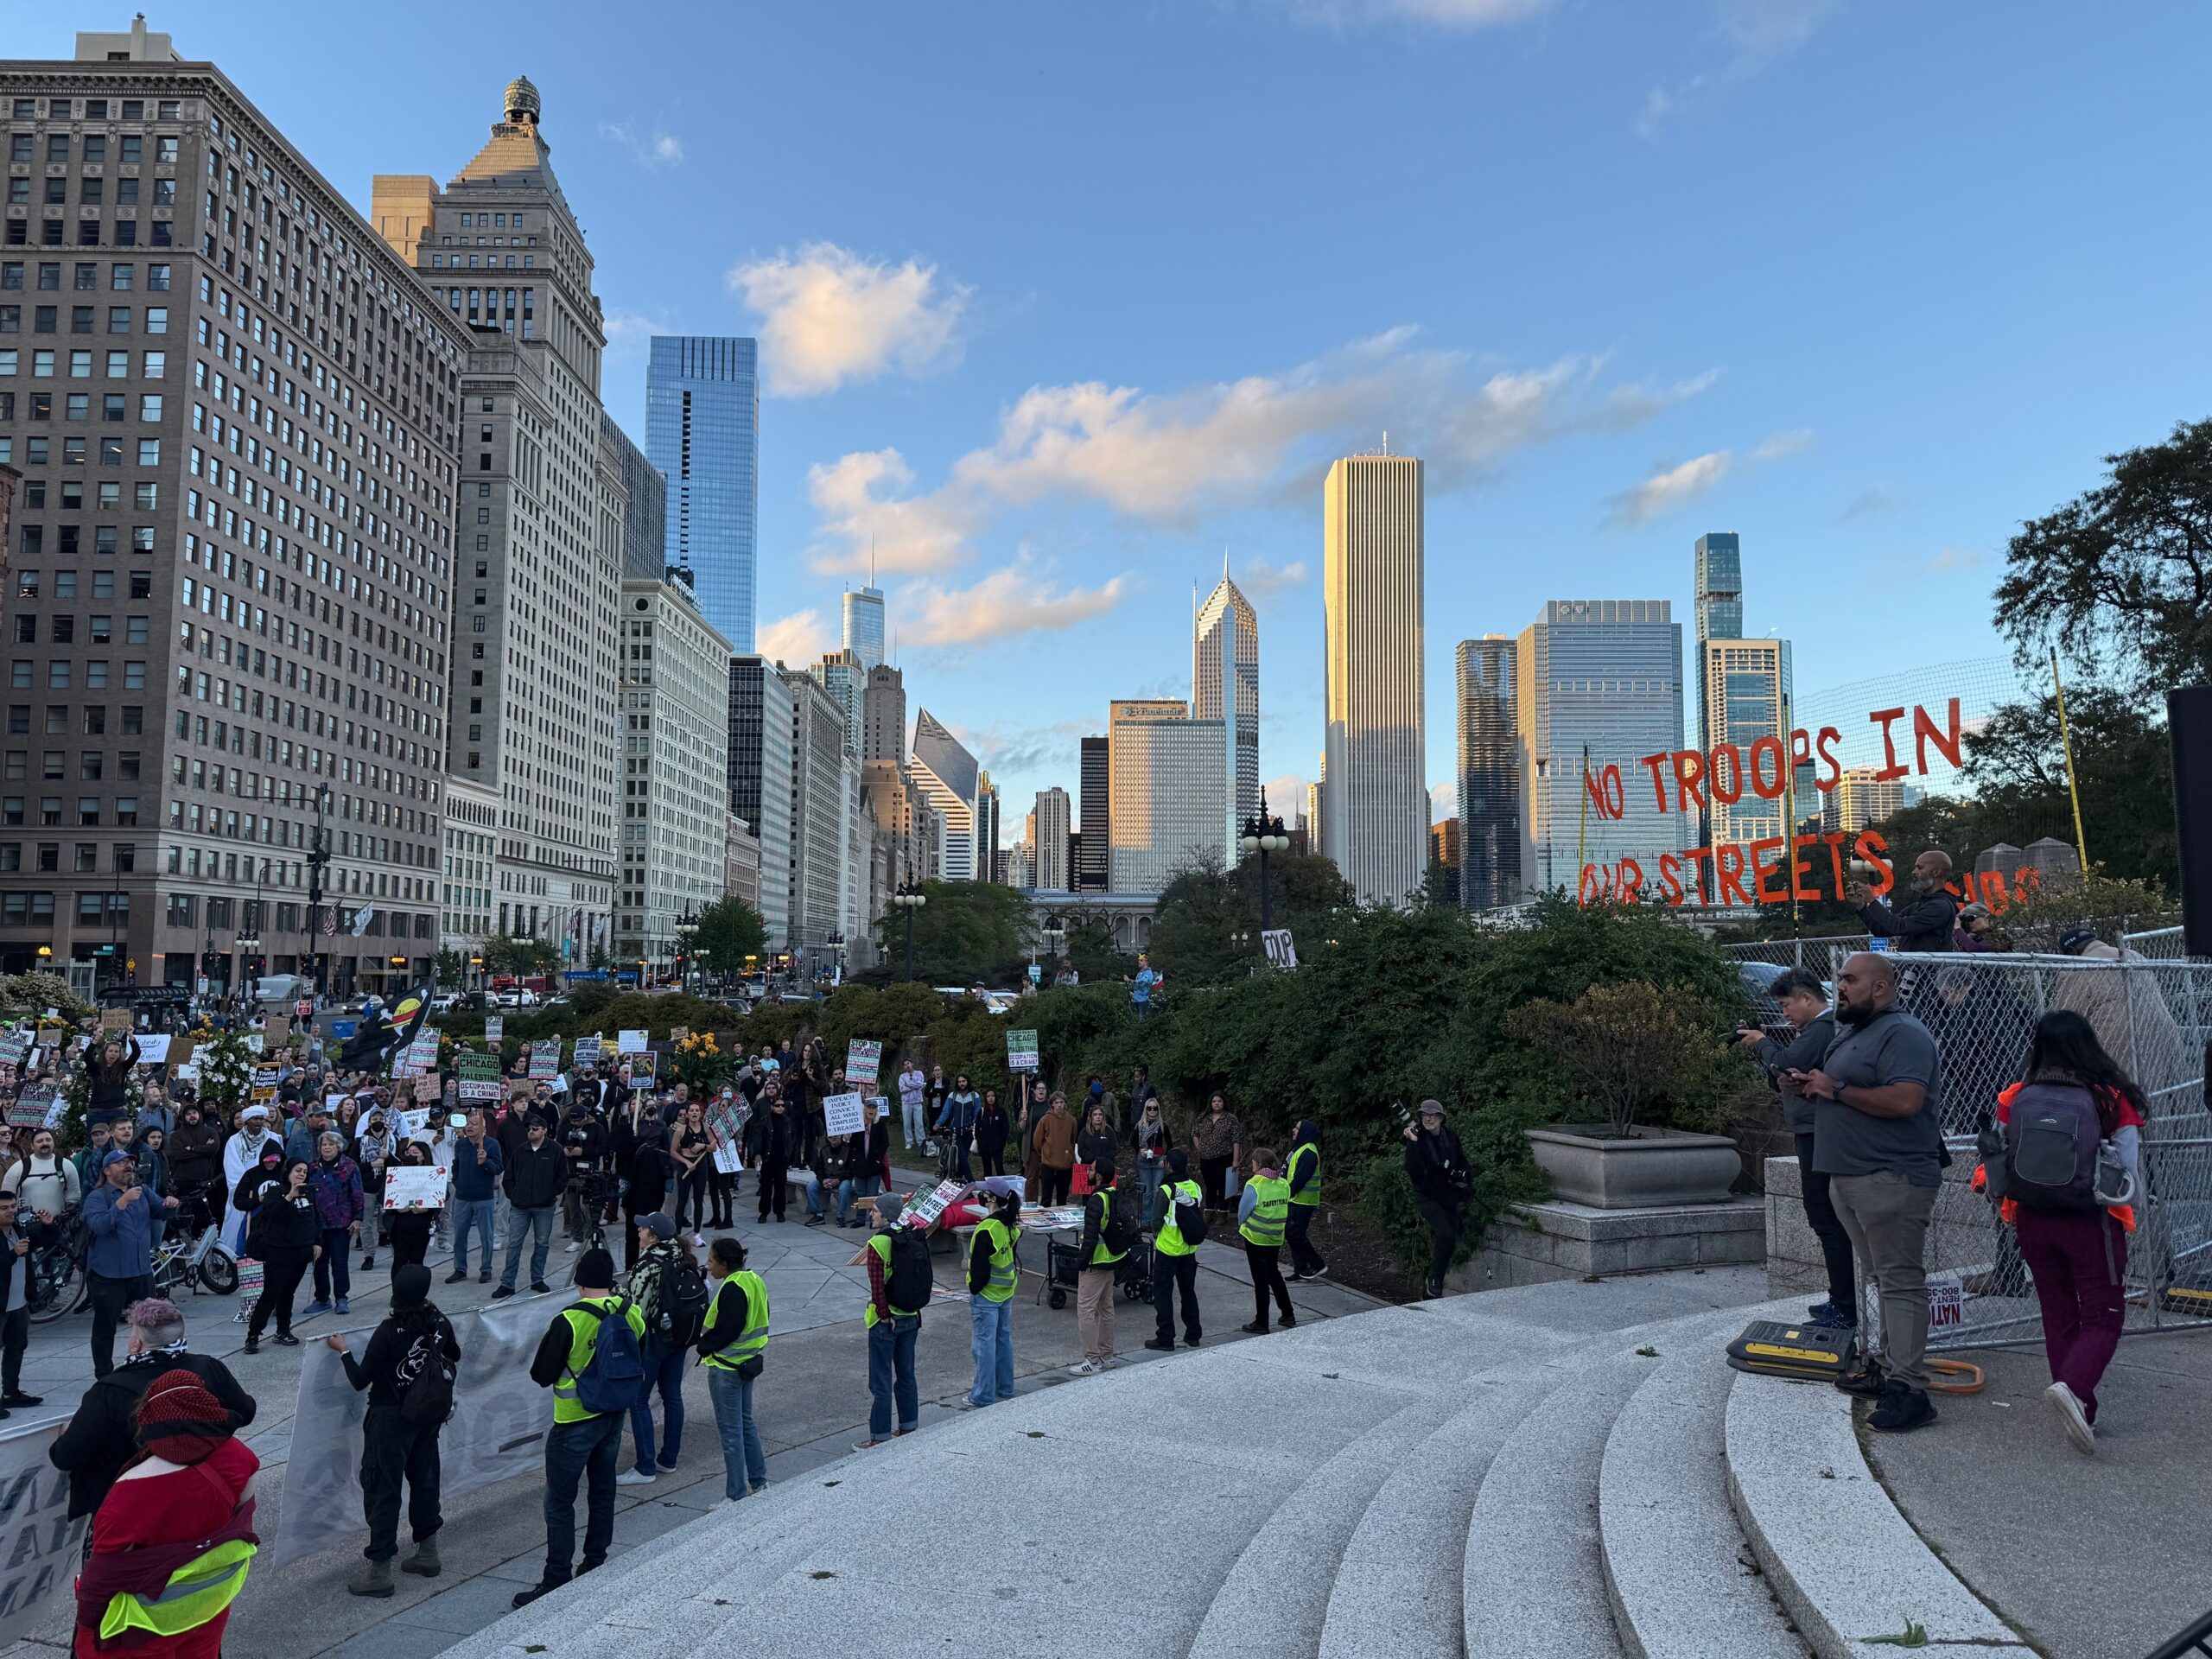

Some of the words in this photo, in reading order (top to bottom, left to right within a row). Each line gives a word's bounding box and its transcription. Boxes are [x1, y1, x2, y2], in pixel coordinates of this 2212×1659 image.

[1586, 764, 1624, 821] NO
[1642, 726, 1842, 813] TROOPS
[1870, 697, 1962, 782] IN
[1579, 857, 1643, 910] OUR
[1660, 830, 1895, 908] STREETS
[460, 1058, 499, 1069] CHICAGO
[460, 1073, 499, 1083] PALESTINE
[828, 1095, 855, 1103] IMPEACH
[829, 1106, 856, 1115] CONVICT
[829, 1117, 859, 1126] COMPLIED
[833, 1122, 861, 1132] TREASON
[929, 1199, 944, 1212] FREE
[1929, 1304, 1961, 1326] NATI
